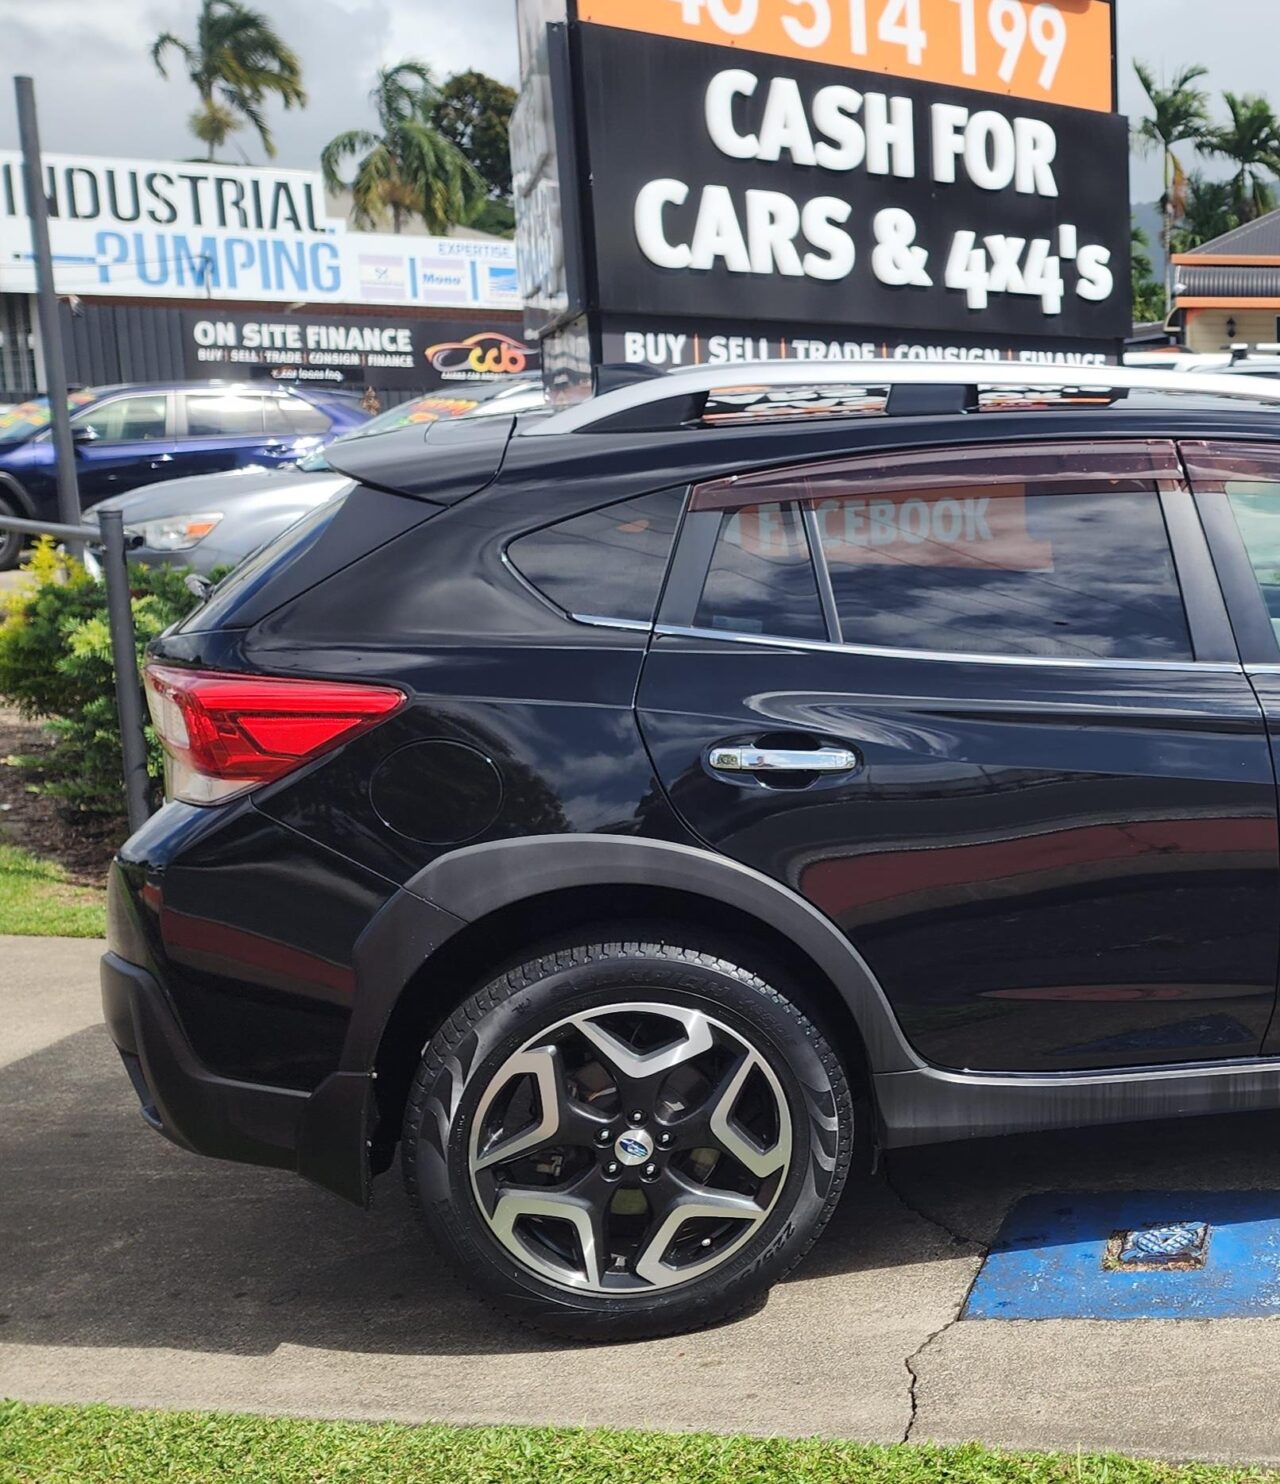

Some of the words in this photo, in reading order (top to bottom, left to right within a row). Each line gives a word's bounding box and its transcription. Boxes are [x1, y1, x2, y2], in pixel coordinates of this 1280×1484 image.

[948, 0, 1067, 91] 199
[705, 68, 915, 179] CASH
[930, 102, 1059, 198] FOR
[95, 230, 342, 293] PUMPING
[634, 178, 856, 281] CARS
[871, 207, 934, 288] &
[193, 320, 237, 347] ON
[241, 323, 303, 349] SITE
[306, 325, 414, 352] FINANCE
[197, 348, 224, 362] BUY
[230, 350, 259, 363] SELL
[264, 351, 302, 364] TRADE
[308, 353, 360, 366] CONSIGN
[367, 354, 414, 368] FINANCE
[624, 331, 687, 365] BUY
[707, 335, 770, 363] SELL
[791, 340, 876, 361] TRADE
[893, 344, 1000, 362] CONSIGN
[757, 496, 994, 552] FCEBOOK
